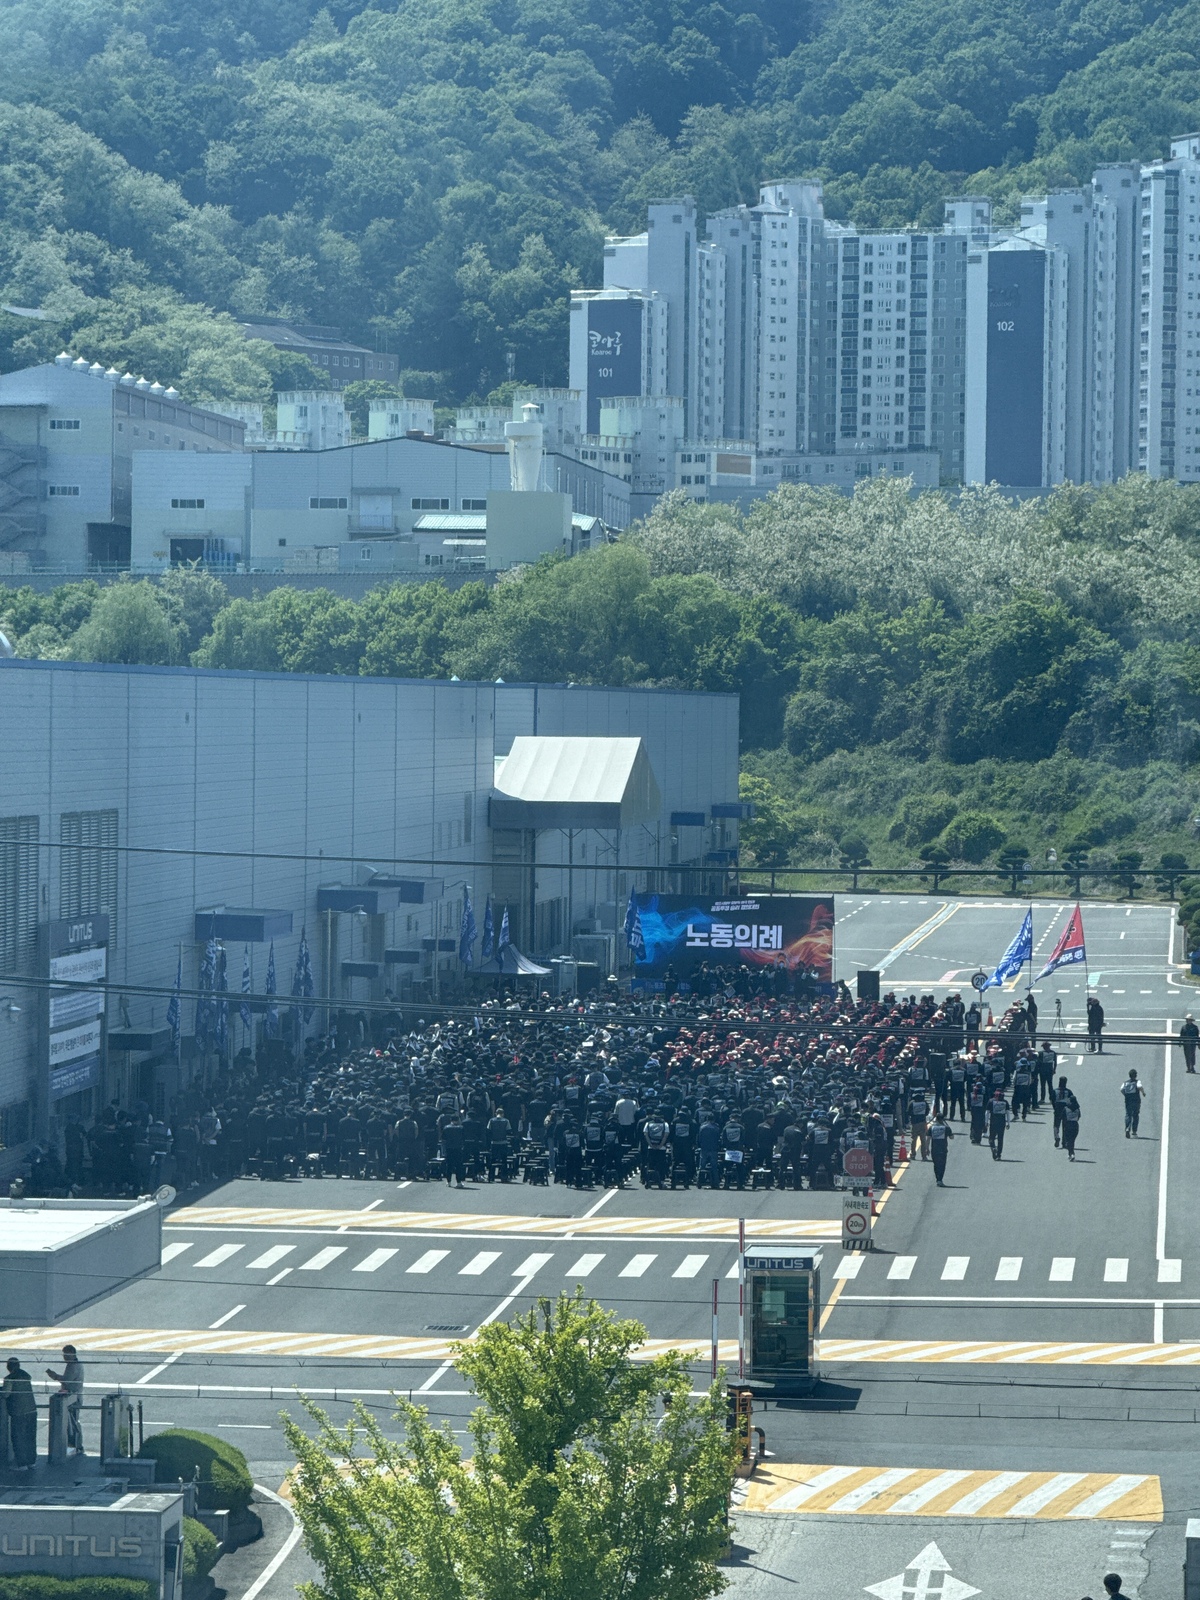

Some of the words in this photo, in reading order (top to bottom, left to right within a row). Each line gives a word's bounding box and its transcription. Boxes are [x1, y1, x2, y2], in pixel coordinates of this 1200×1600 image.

[997, 321, 1015, 331] 102
[598, 368, 613, 378] 101
[686, 923, 783, 949] 노동의례
[975, 977, 985, 986] 20
[746, 1258, 804, 1269] UNITUS
[2, 1533, 143, 1558] UNITUS
